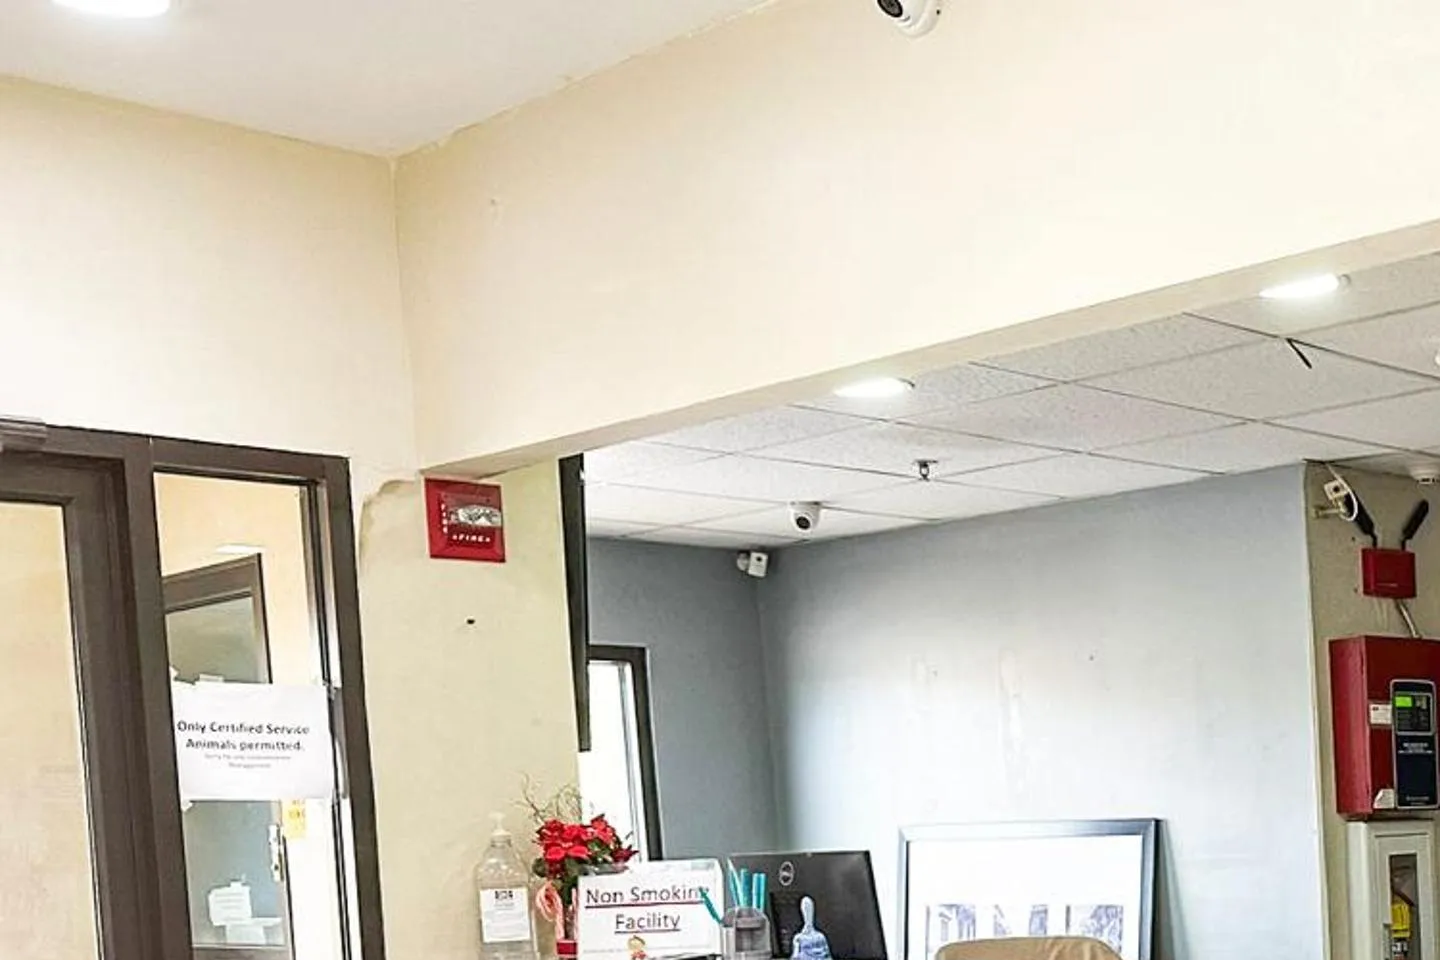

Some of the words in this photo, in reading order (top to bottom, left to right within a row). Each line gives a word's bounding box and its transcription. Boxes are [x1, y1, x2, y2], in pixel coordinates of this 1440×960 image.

[177, 720, 206, 734] Only
[209, 721, 263, 735] Certified
[266, 723, 310, 735] Service
[186, 738, 237, 750] Animals
[586, 889, 623, 904] Non
[615, 912, 681, 930] Facility
